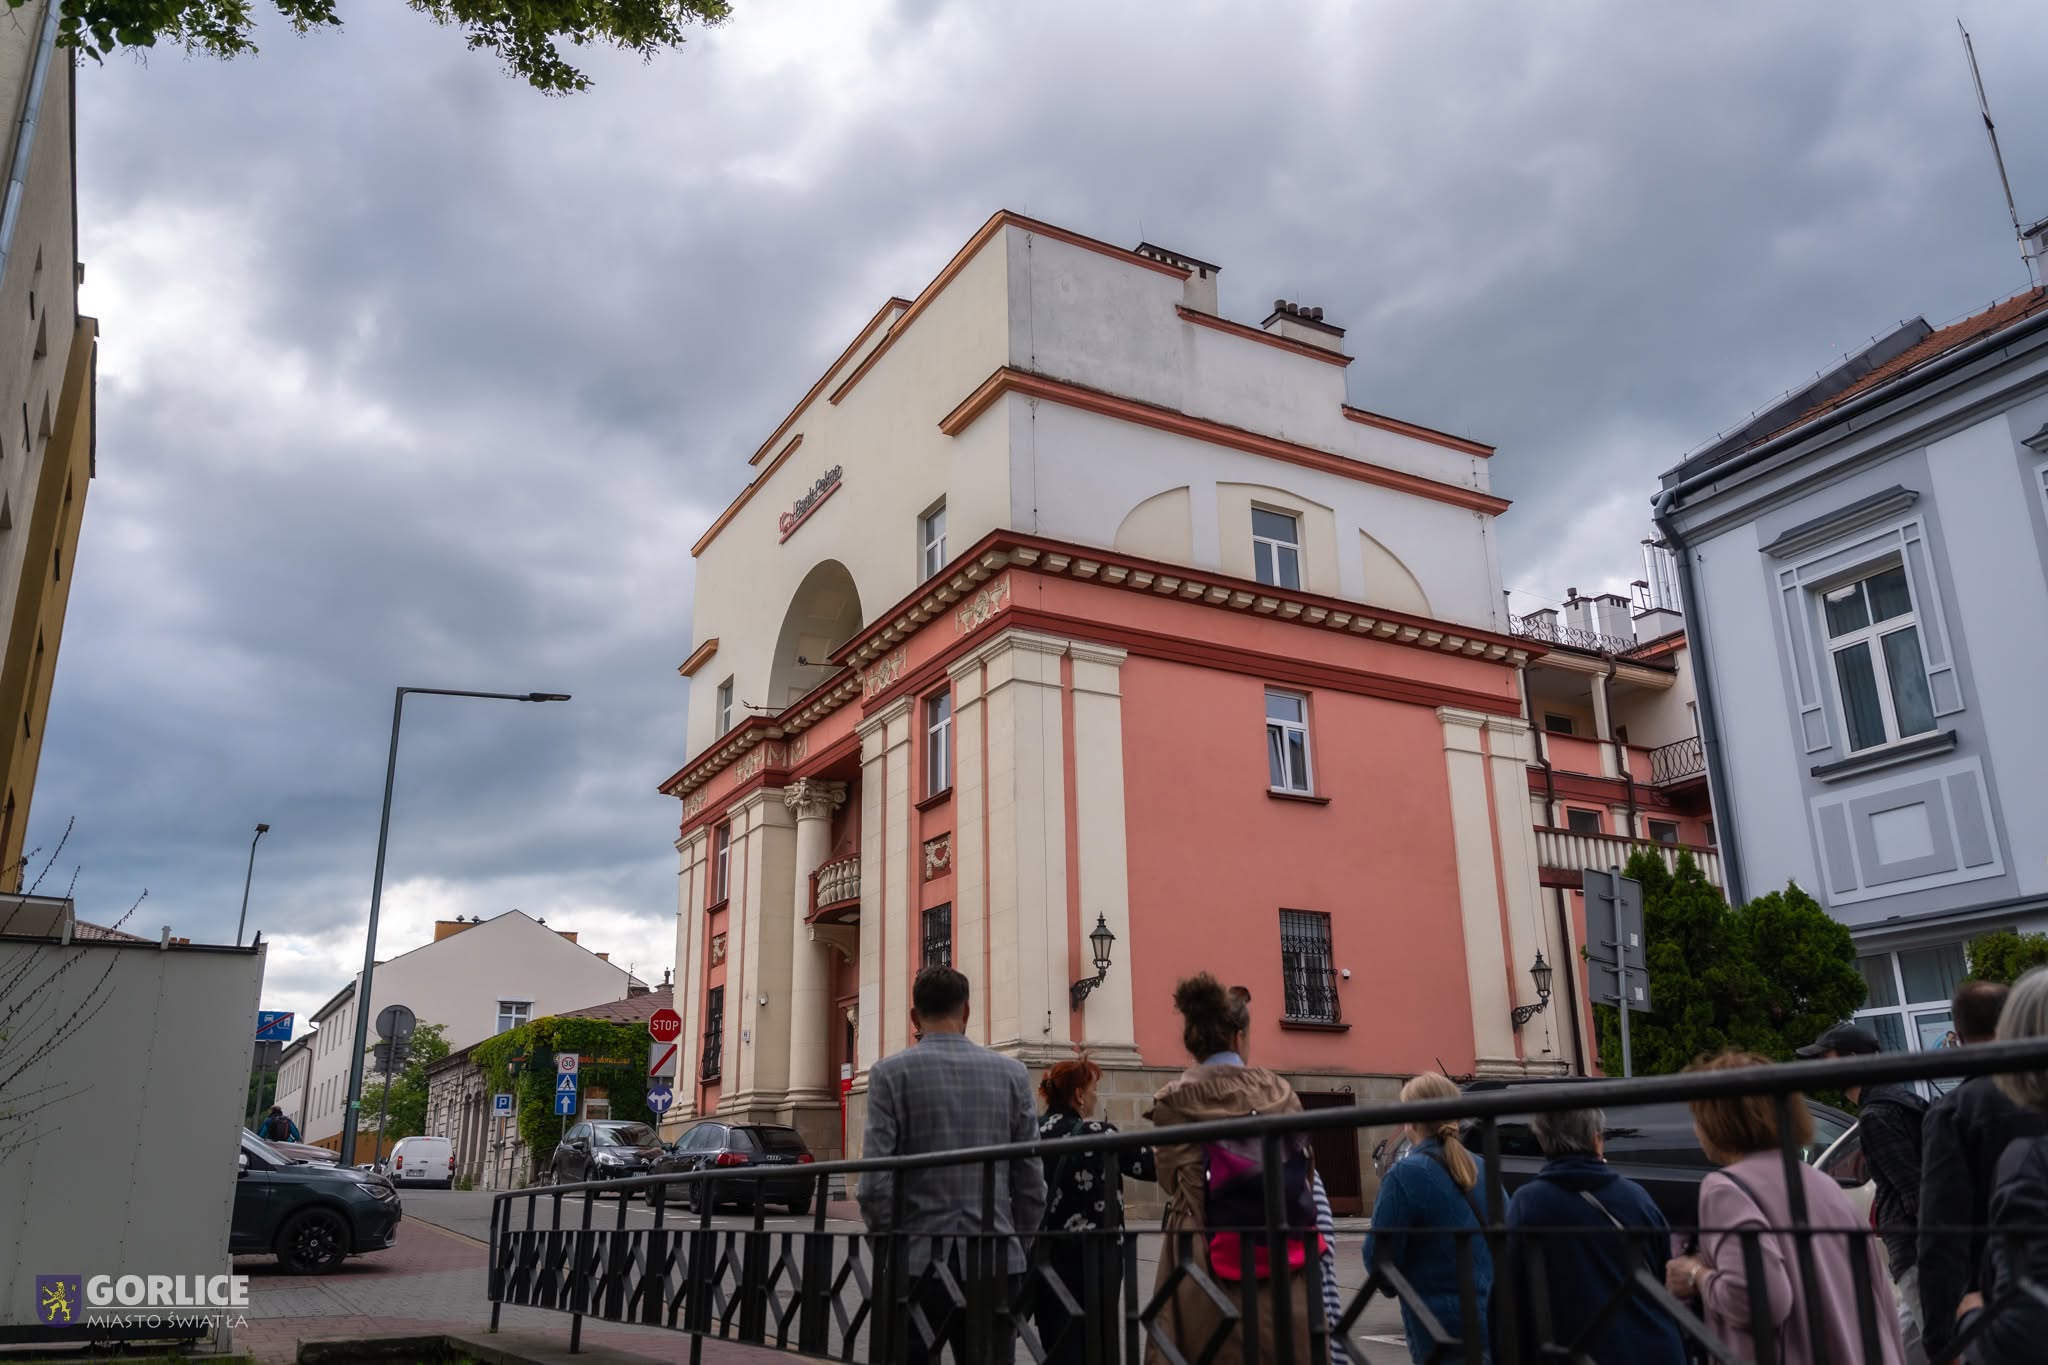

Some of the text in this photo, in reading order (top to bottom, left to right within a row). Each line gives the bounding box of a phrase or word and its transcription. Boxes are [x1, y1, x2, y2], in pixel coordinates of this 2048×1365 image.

[795, 464, 843, 518] Bank Pekao
[652, 1019, 679, 1031] STOP
[499, 1097, 507, 1108] P
